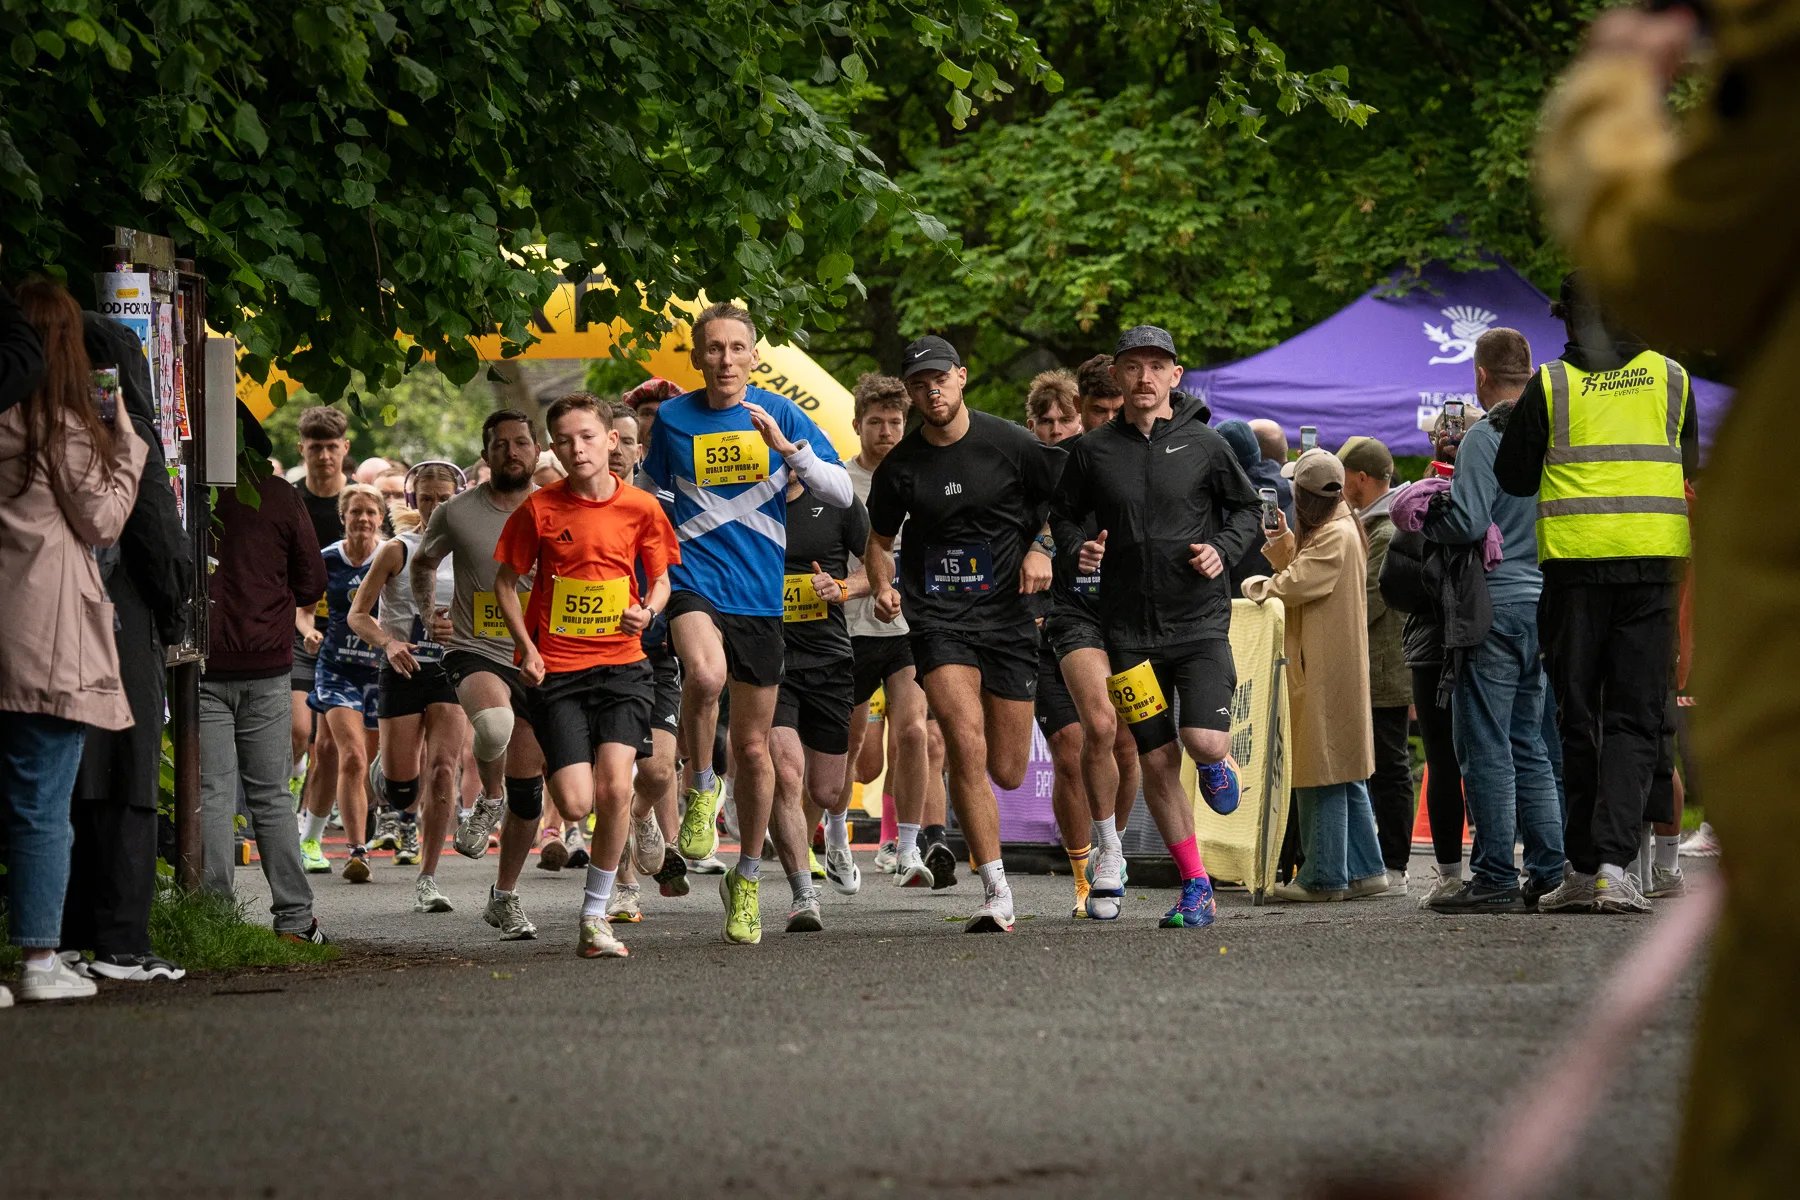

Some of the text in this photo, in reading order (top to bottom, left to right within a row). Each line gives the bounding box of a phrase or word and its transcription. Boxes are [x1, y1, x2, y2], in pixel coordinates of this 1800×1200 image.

[124, 303, 140, 314] FOR
[1604, 368, 1648, 380] UP AND
[1600, 376, 1655, 391] RUNNING
[766, 375, 820, 411] AND
[1614, 388, 1640, 397] EVENTS
[706, 445, 741, 464] 533
[705, 463, 760, 474] WORLD CUP WARM-UP
[944, 481, 962, 496] alto
[940, 558, 960, 574] 15
[935, 574, 950, 582] WORLD
[961, 574, 984, 582] WARM-UP
[783, 587, 800, 602] 41
[565, 594, 603, 614] 552
[562, 614, 581, 624] WORLD
[583, 616, 594, 625] CUP
[345, 634, 360, 649] 17
